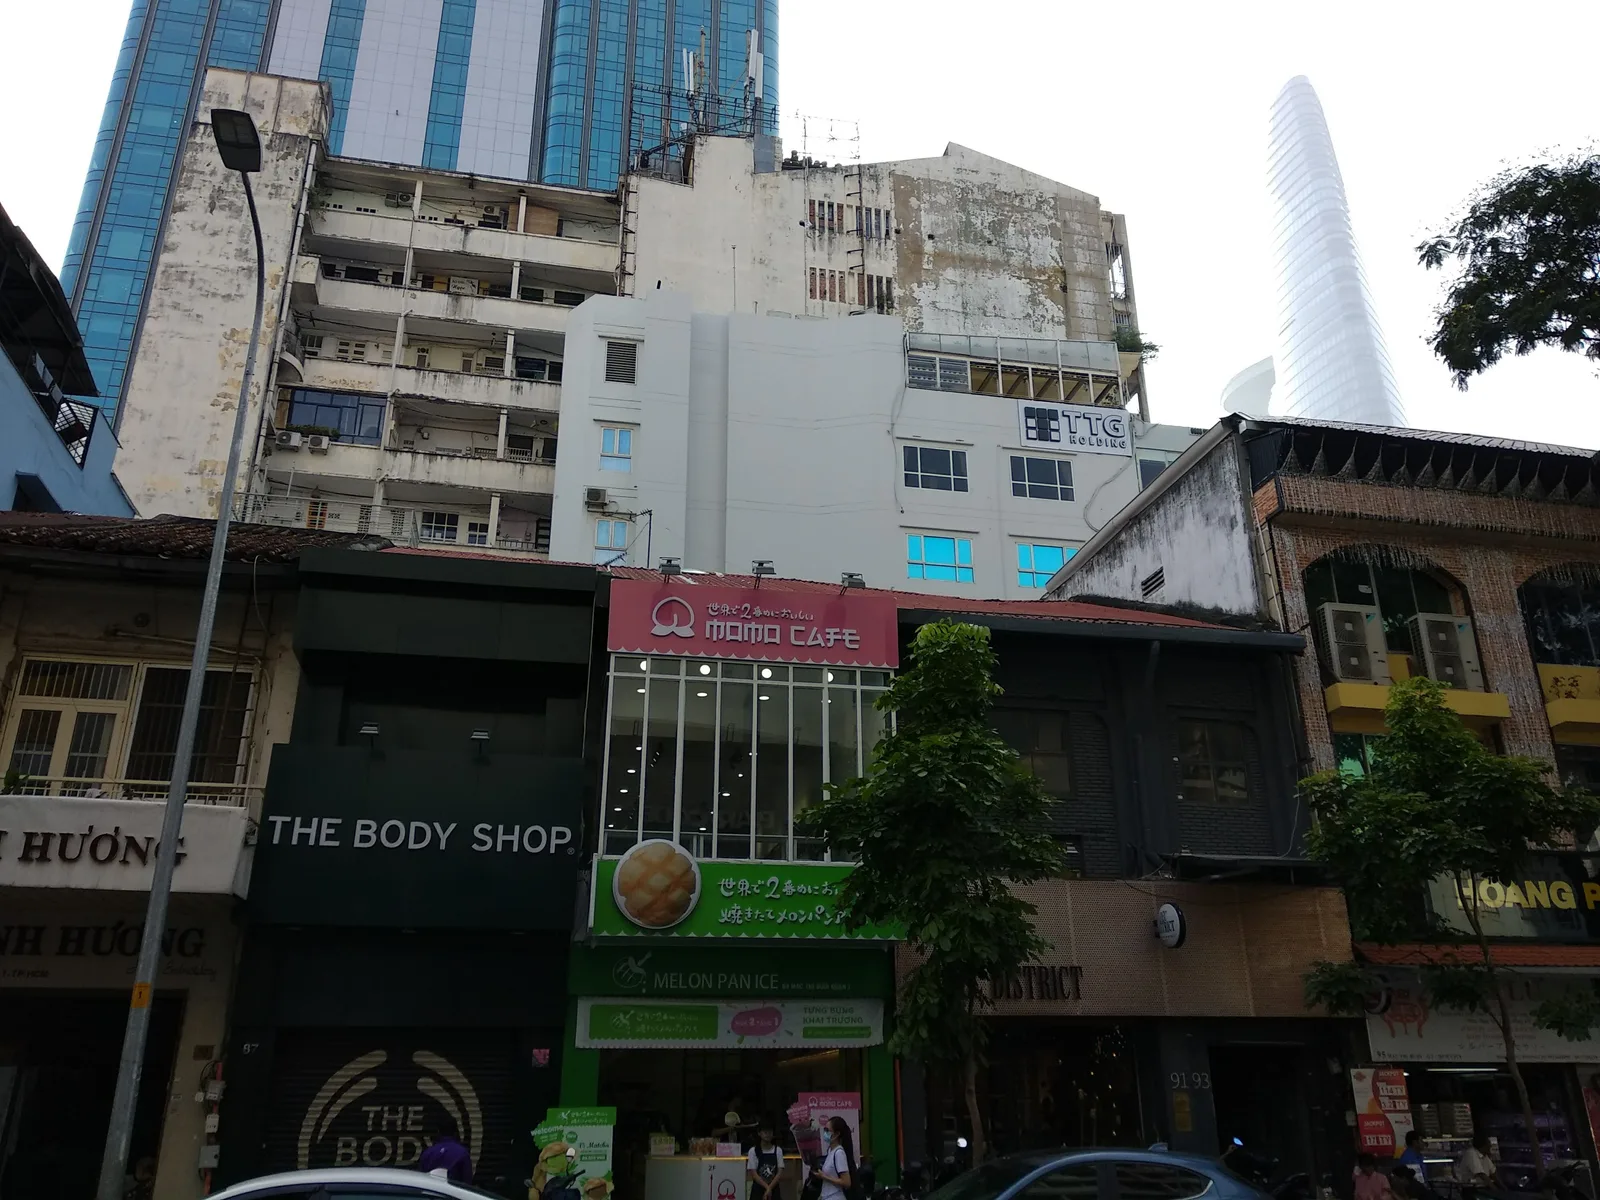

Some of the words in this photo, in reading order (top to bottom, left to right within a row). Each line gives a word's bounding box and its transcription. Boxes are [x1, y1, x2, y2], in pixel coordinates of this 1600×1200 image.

[1062, 410, 1126, 438] TTG
[1069, 435, 1127, 449] HOLDING
[705, 619, 781, 645] MOMO
[268, 815, 343, 847] THE
[353, 818, 459, 851] BODY
[653, 972, 714, 990] MELON
[718, 973, 754, 990] PAN
[755, 973, 779, 990] ICE
[991, 966, 1083, 1000] DISTRICT
[361, 1104, 425, 1132] THE
